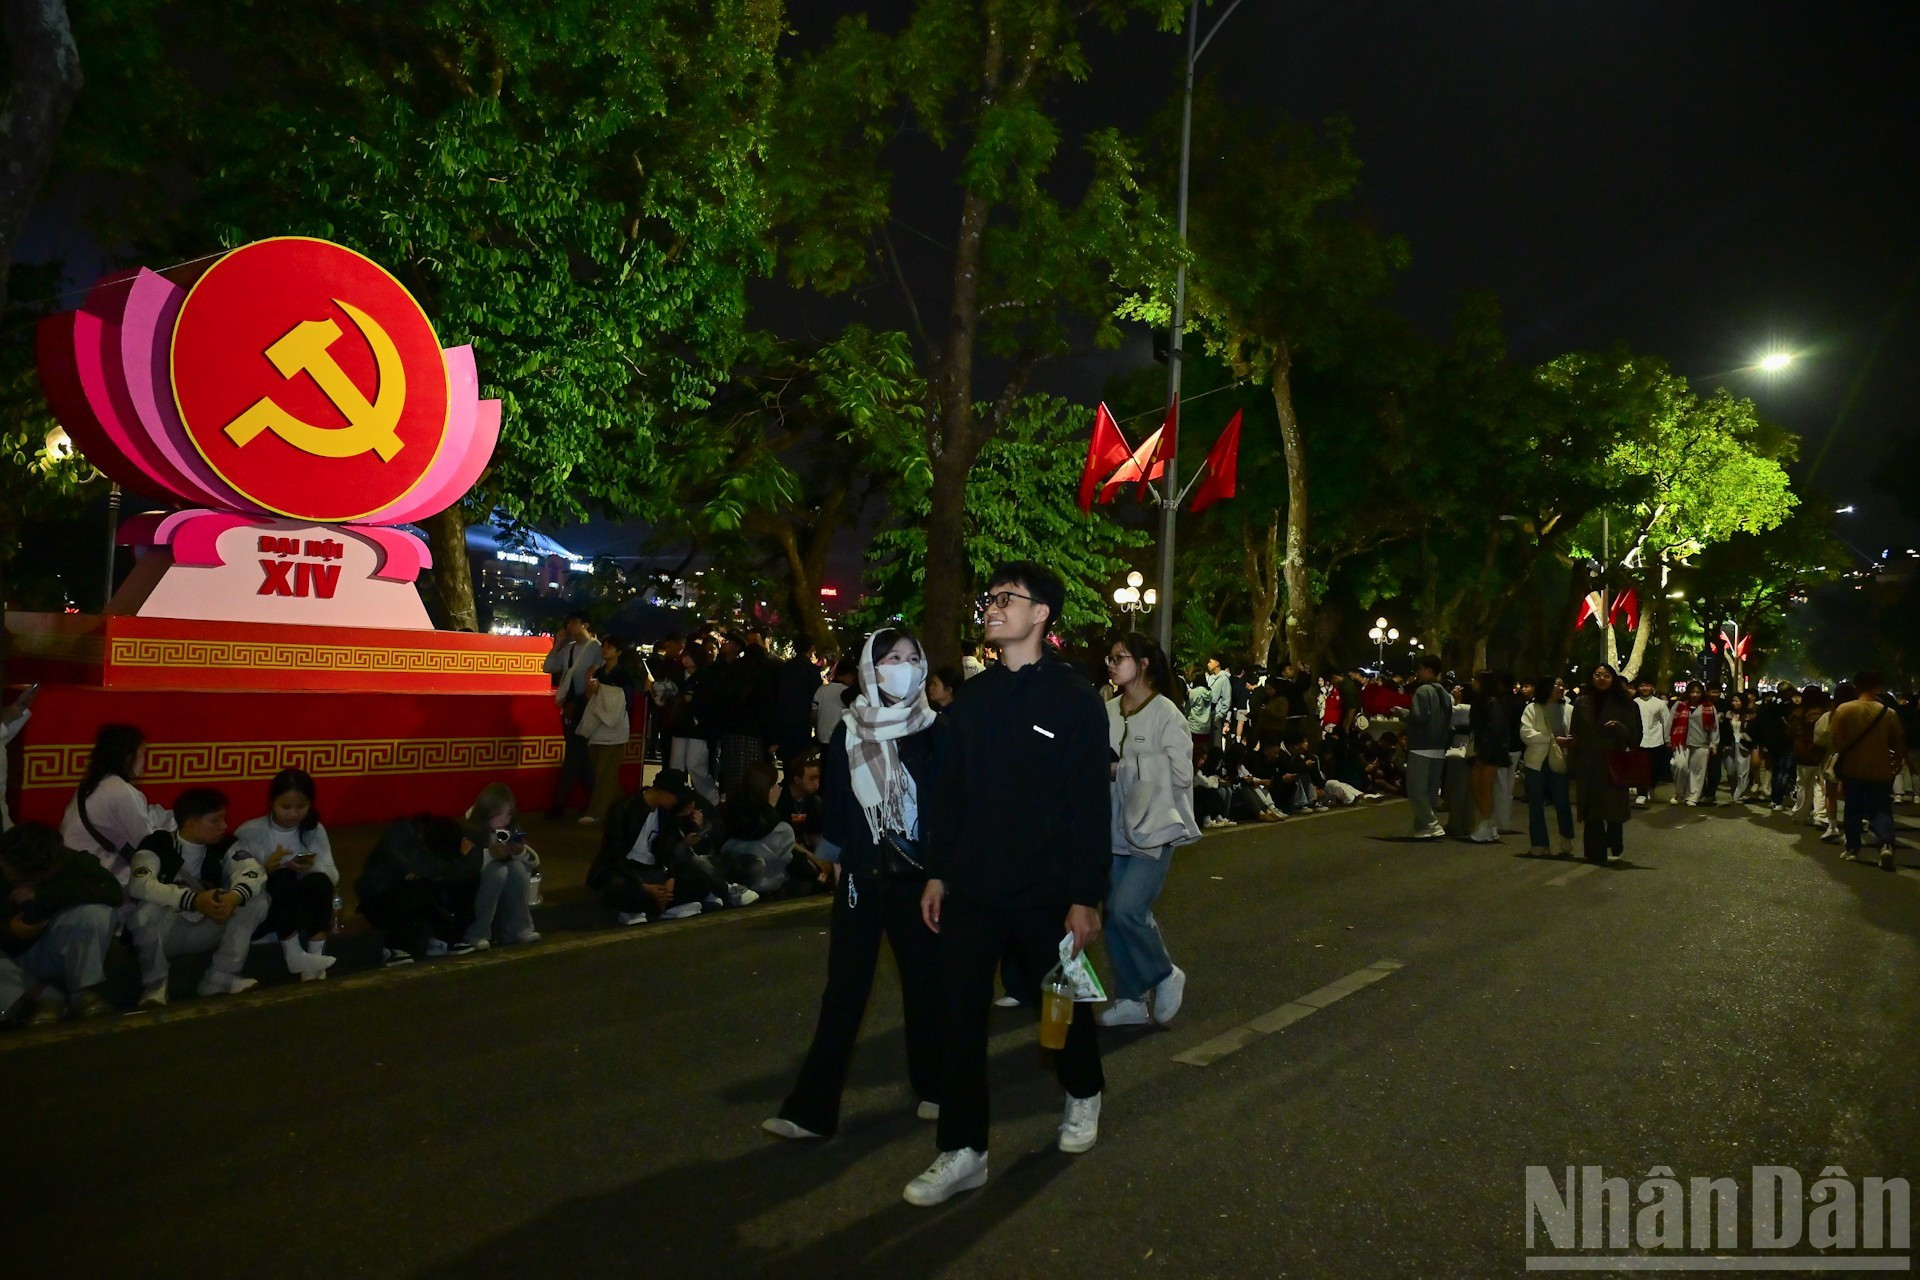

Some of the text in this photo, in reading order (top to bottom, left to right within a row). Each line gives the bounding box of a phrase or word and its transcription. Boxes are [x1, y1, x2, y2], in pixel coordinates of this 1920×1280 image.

[257, 535, 344, 562] ĐẠI HỘI
[256, 559, 342, 599] XIV
